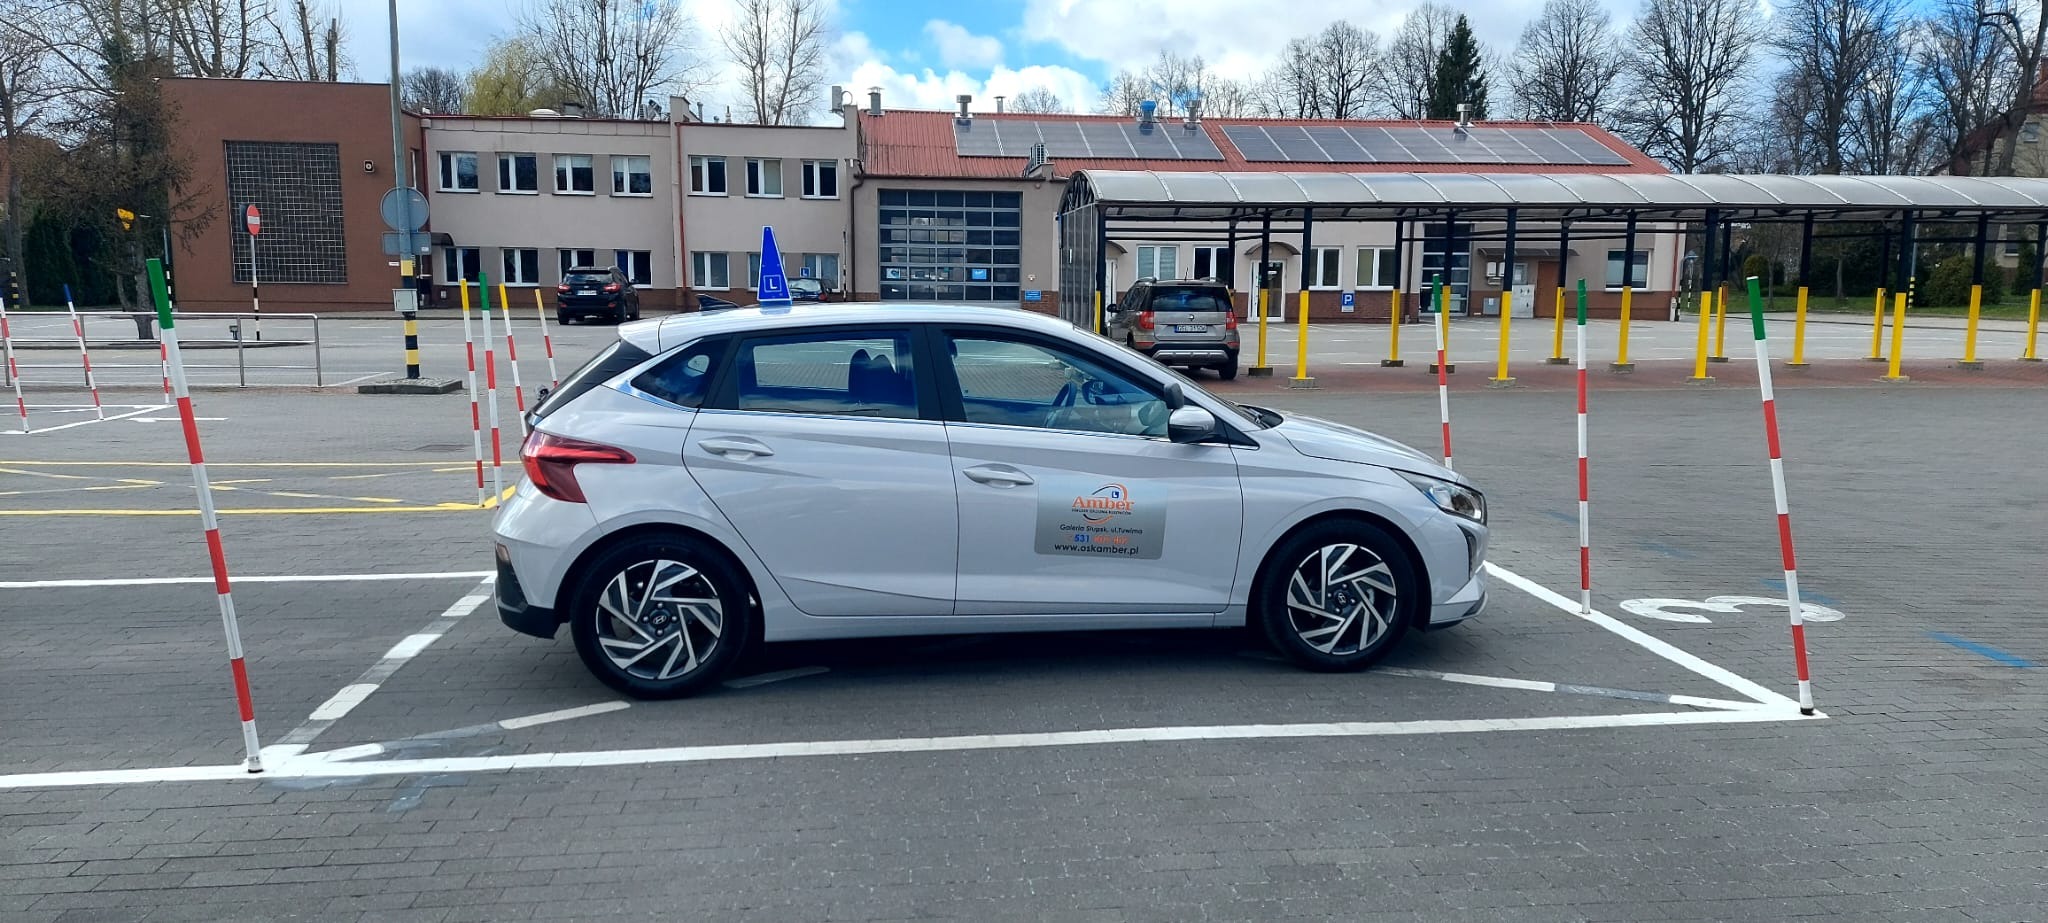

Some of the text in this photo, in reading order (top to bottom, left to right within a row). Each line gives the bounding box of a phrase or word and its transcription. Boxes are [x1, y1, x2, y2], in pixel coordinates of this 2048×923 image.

[769, 278, 778, 289] L
[1344, 294, 1352, 304] P
[1072, 495, 1135, 511] Amber
[1074, 534, 1090, 543] 531
[1054, 543, 1139, 556] www.oskamber.pl
